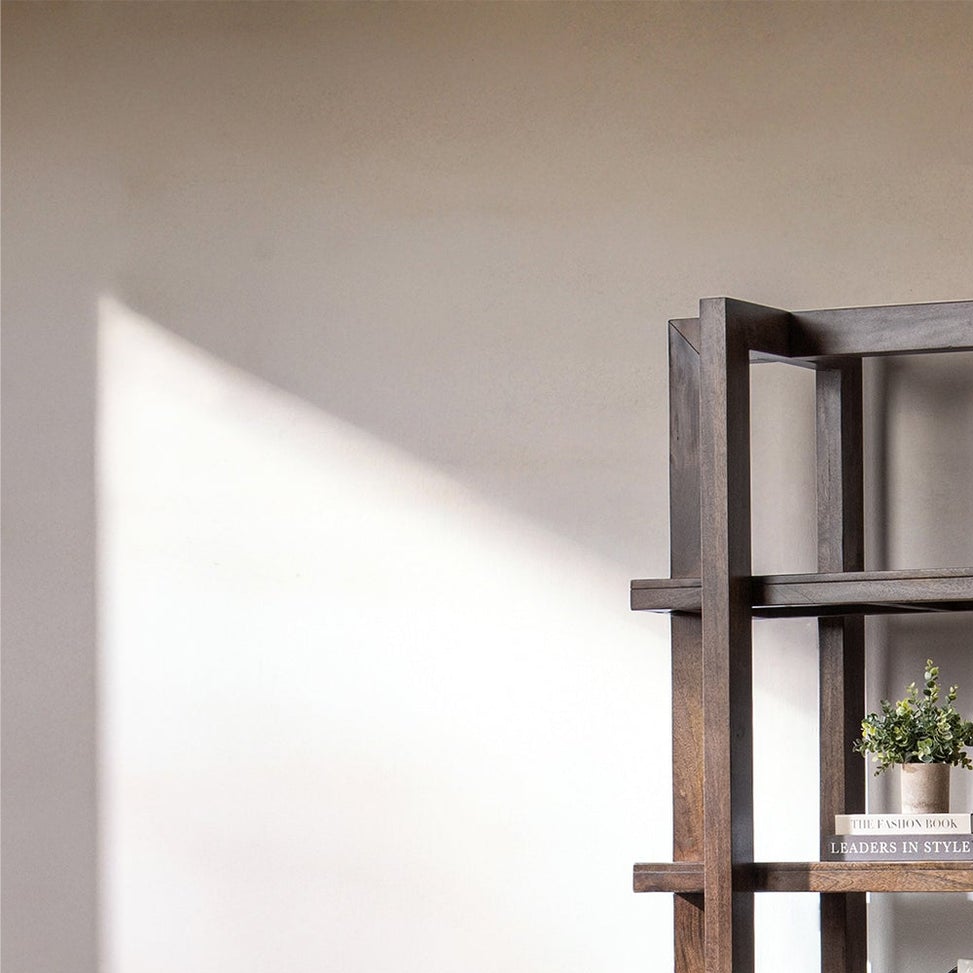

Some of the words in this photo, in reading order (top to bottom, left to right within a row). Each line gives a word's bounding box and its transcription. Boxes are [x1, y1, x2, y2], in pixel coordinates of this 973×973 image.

[850, 818, 873, 829] THE
[877, 818, 922, 829] FASHION
[926, 818, 958, 829] BOOK
[830, 841, 897, 854] LEADERS
[903, 841, 918, 853] IN
[924, 841, 971, 853] STYLE
